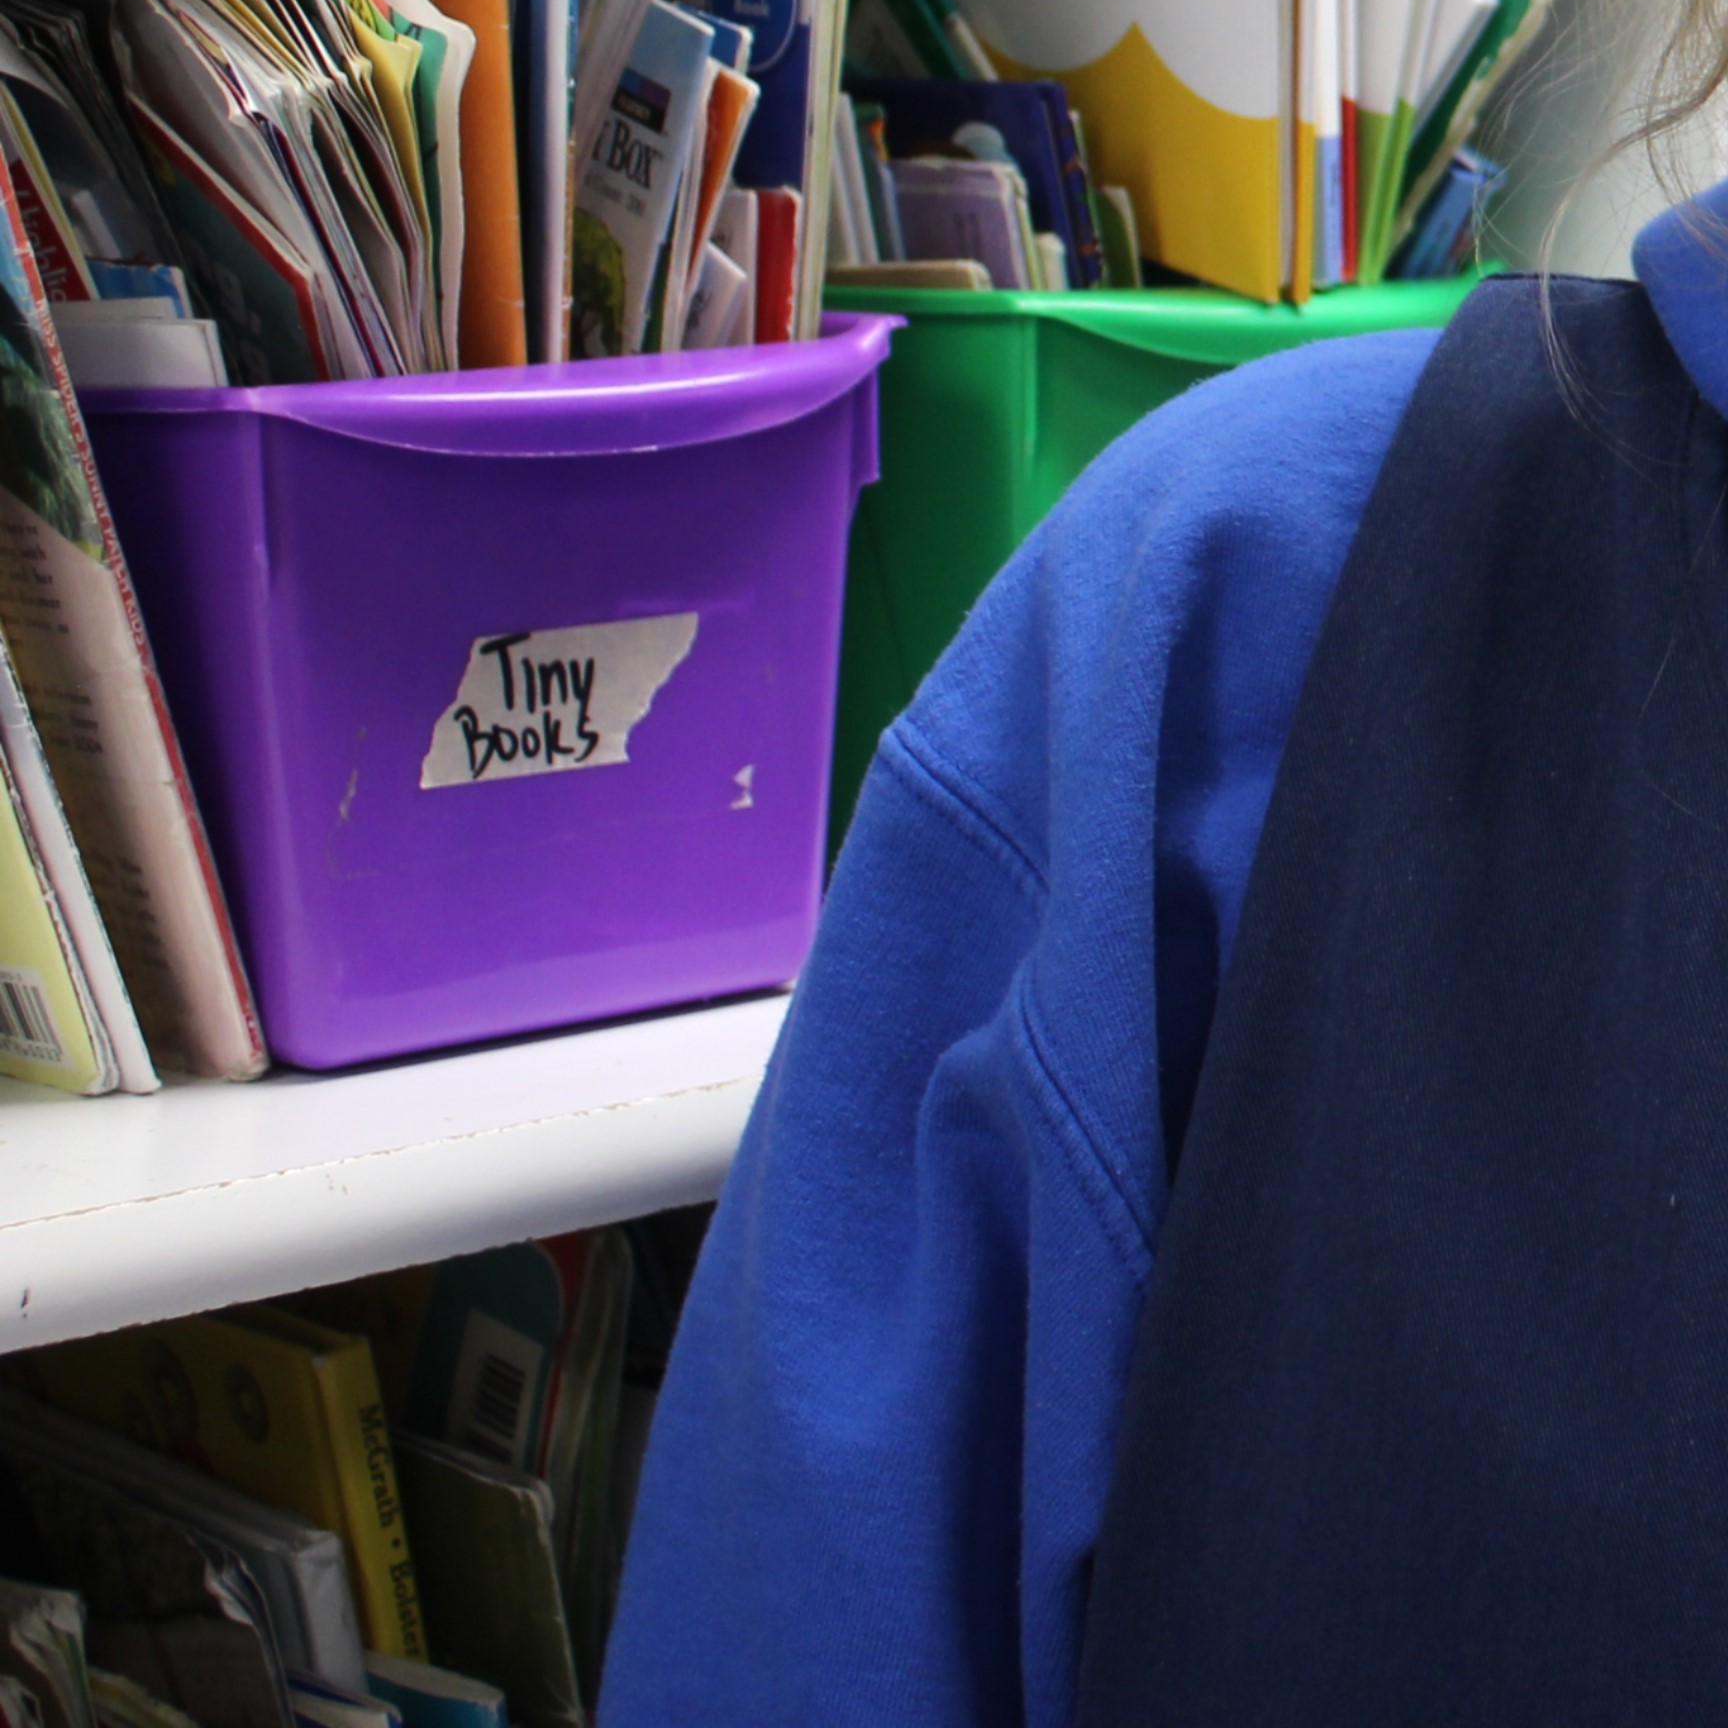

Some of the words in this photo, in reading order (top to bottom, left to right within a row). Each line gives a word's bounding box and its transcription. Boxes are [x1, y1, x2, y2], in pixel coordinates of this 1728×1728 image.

[35, 297, 57, 349] MISS
[50, 351, 83, 442] SPIDER'S
[80, 450, 107, 518] SUNNY
[102, 525, 132, 592] PATCH
[124, 598, 147, 646] KIDS
[453, 705, 600, 780] Books
[480, 632, 595, 722] Tiny
[357, 1402, 400, 1528] McGrath
[389, 1560, 422, 1658] Bolster
